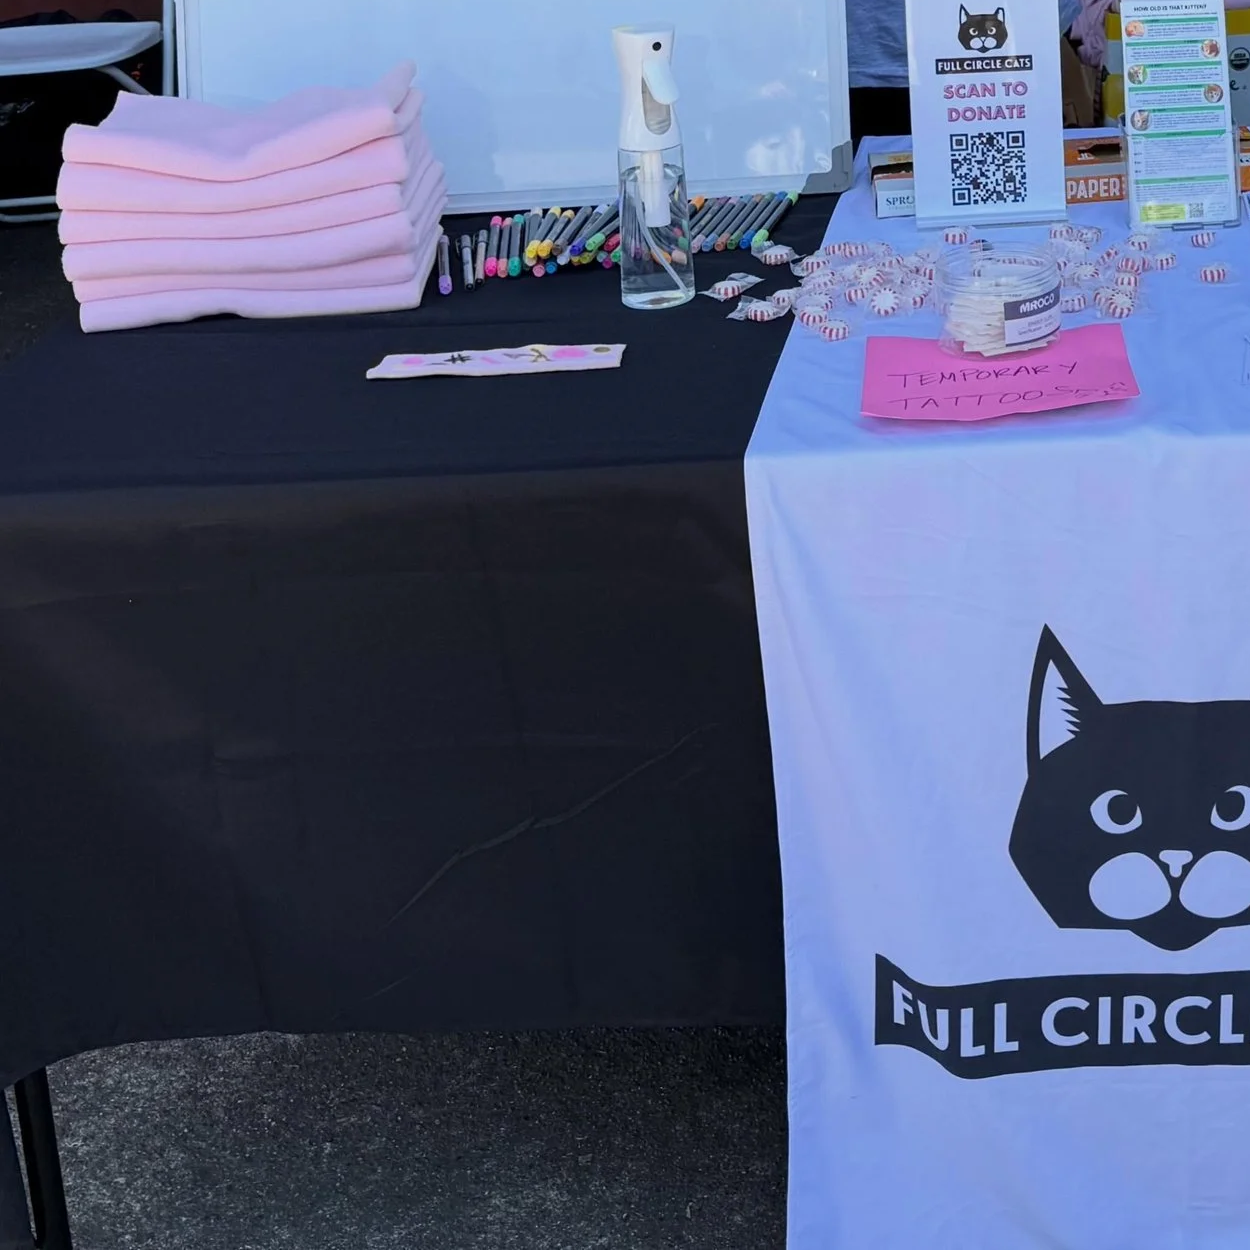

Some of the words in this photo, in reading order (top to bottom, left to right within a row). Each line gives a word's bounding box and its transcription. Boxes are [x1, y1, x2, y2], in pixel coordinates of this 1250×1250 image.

[938, 61, 961, 71] FULL
[963, 59, 1002, 70] CIRCLE
[1004, 58, 1031, 68] CATS
[943, 82, 996, 100] SCAN
[1002, 81, 1028, 97] TO
[947, 104, 1026, 123] DONATE
[1066, 178, 1120, 199] PAPER
[1019, 292, 1055, 313] MROCO
[887, 361, 1079, 388] TEMPORARY
[891, 979, 1020, 1058] FULL
